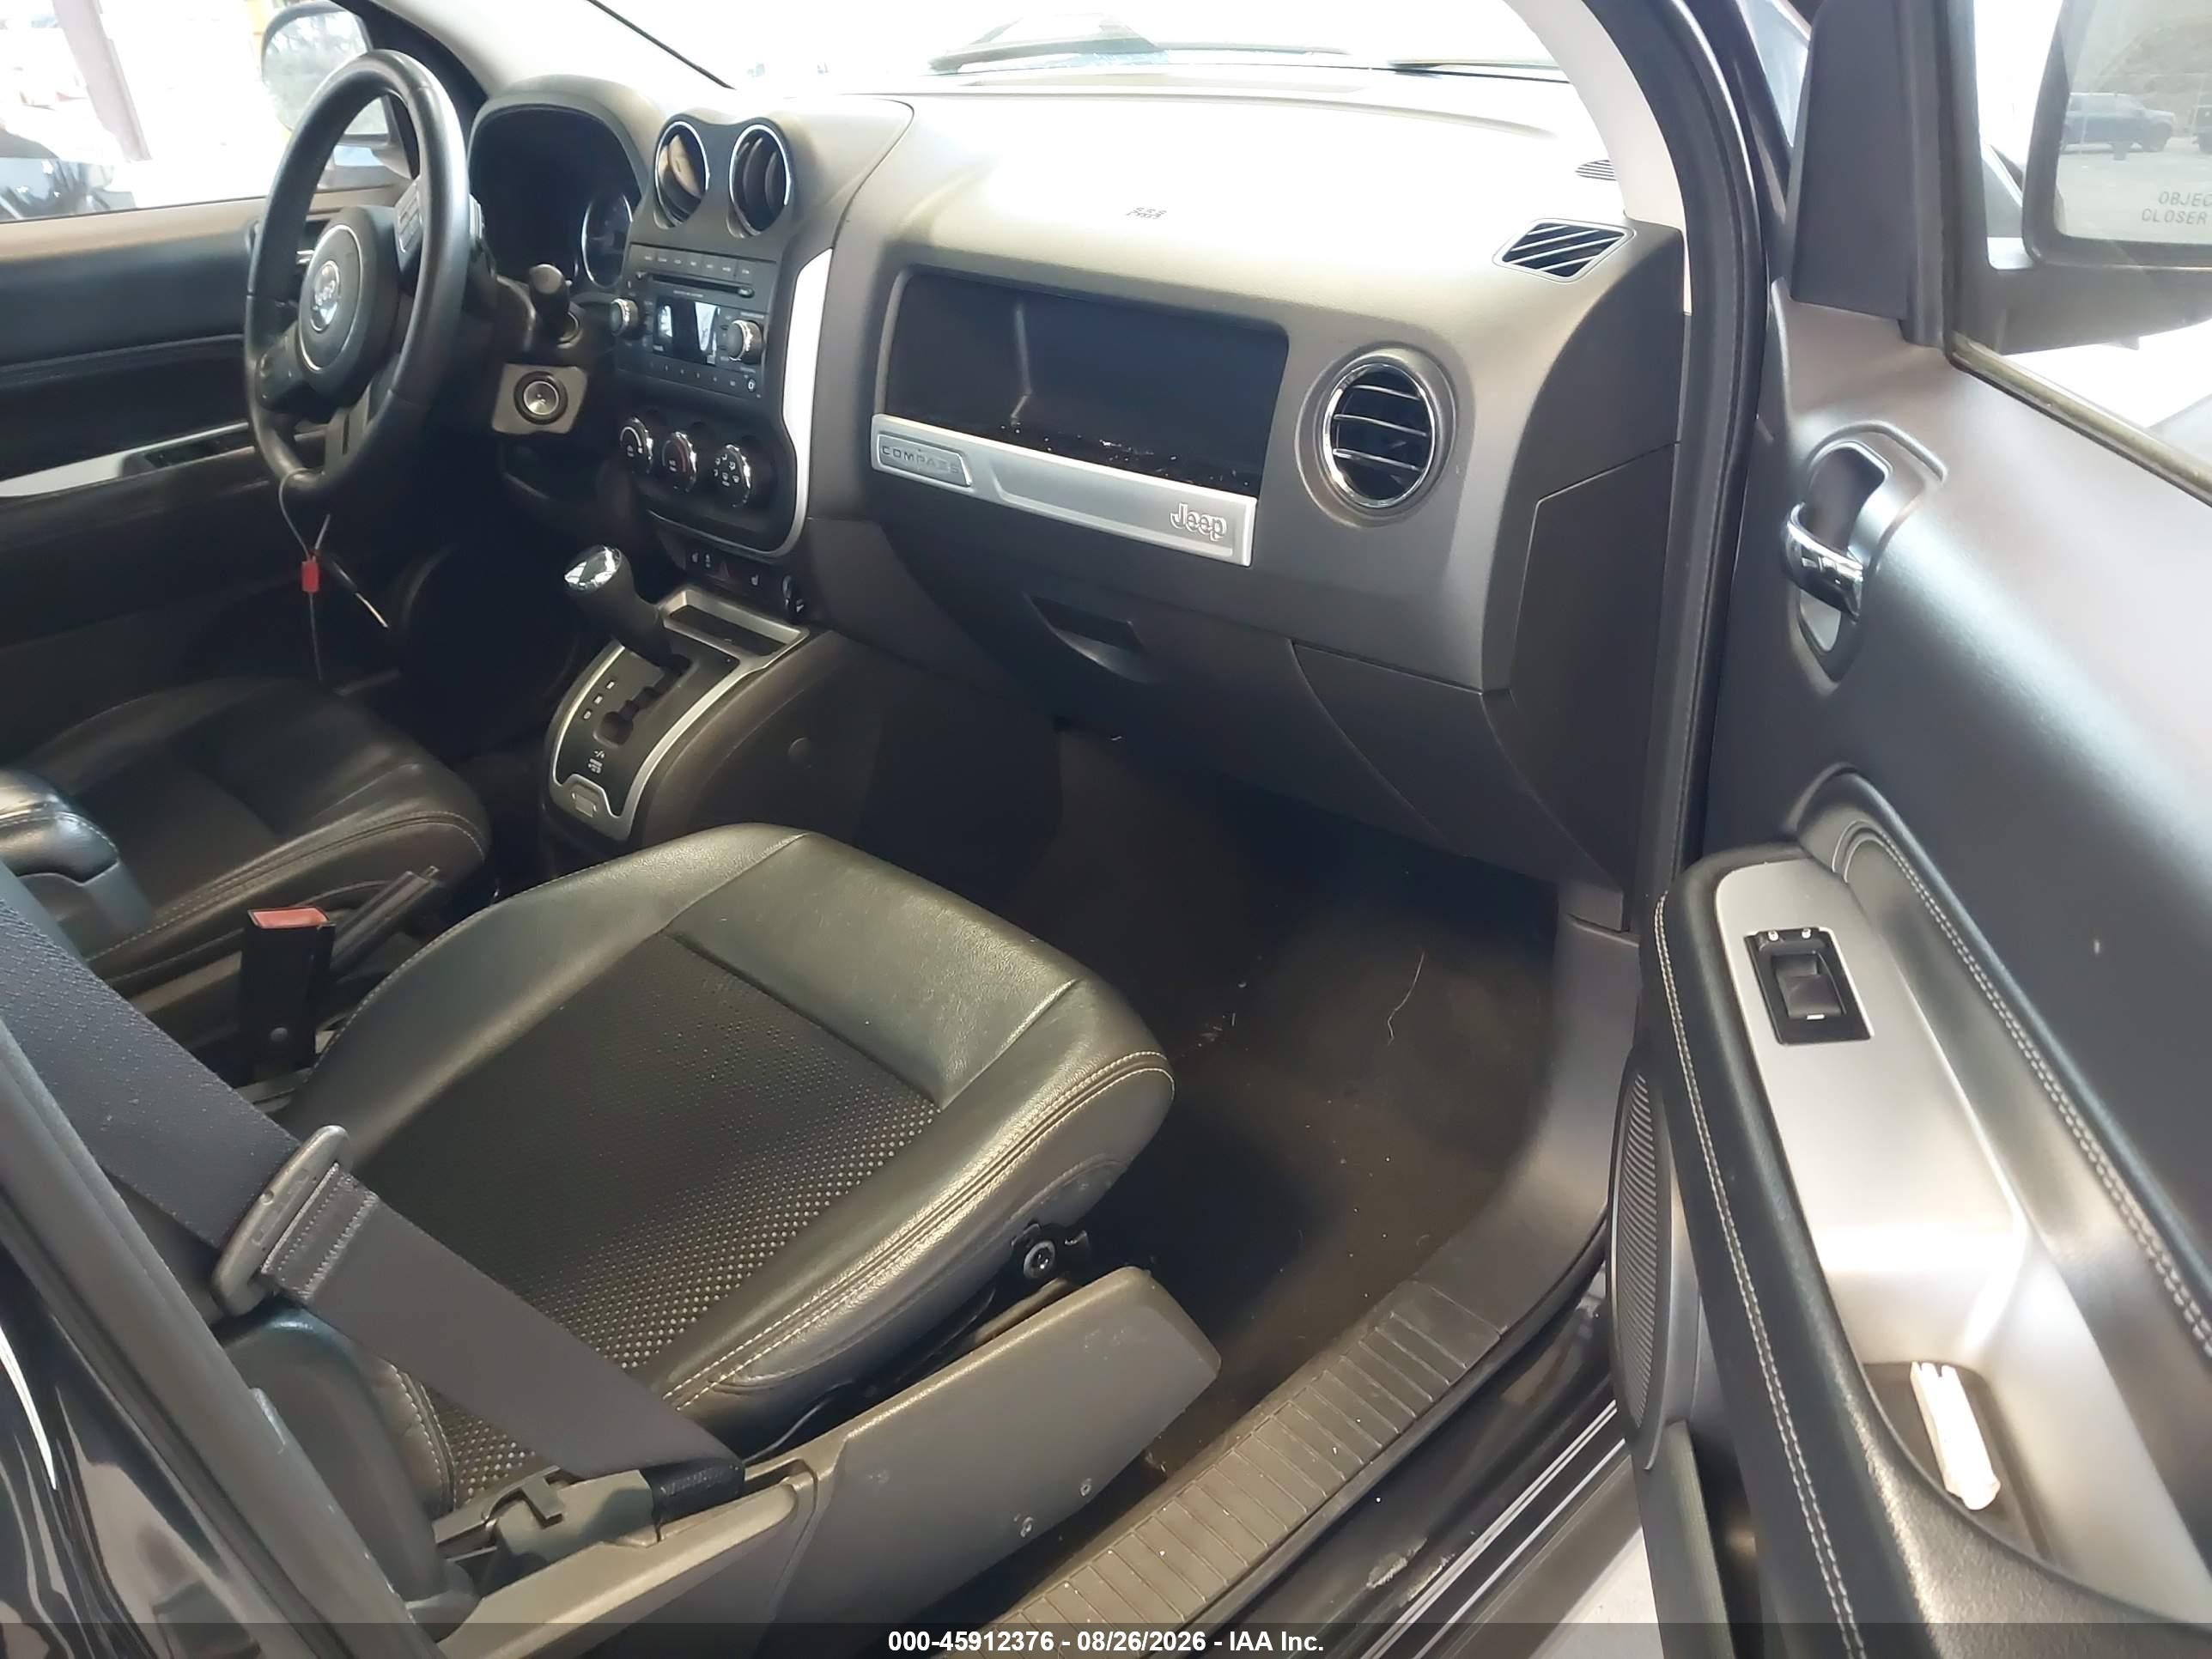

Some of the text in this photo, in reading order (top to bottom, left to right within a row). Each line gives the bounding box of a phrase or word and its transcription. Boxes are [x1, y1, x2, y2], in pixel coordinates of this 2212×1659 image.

[2142, 208, 2208, 225] CLOSER
[881, 446, 960, 474] COMPASS
[1170, 502, 1227, 542] Jeep
